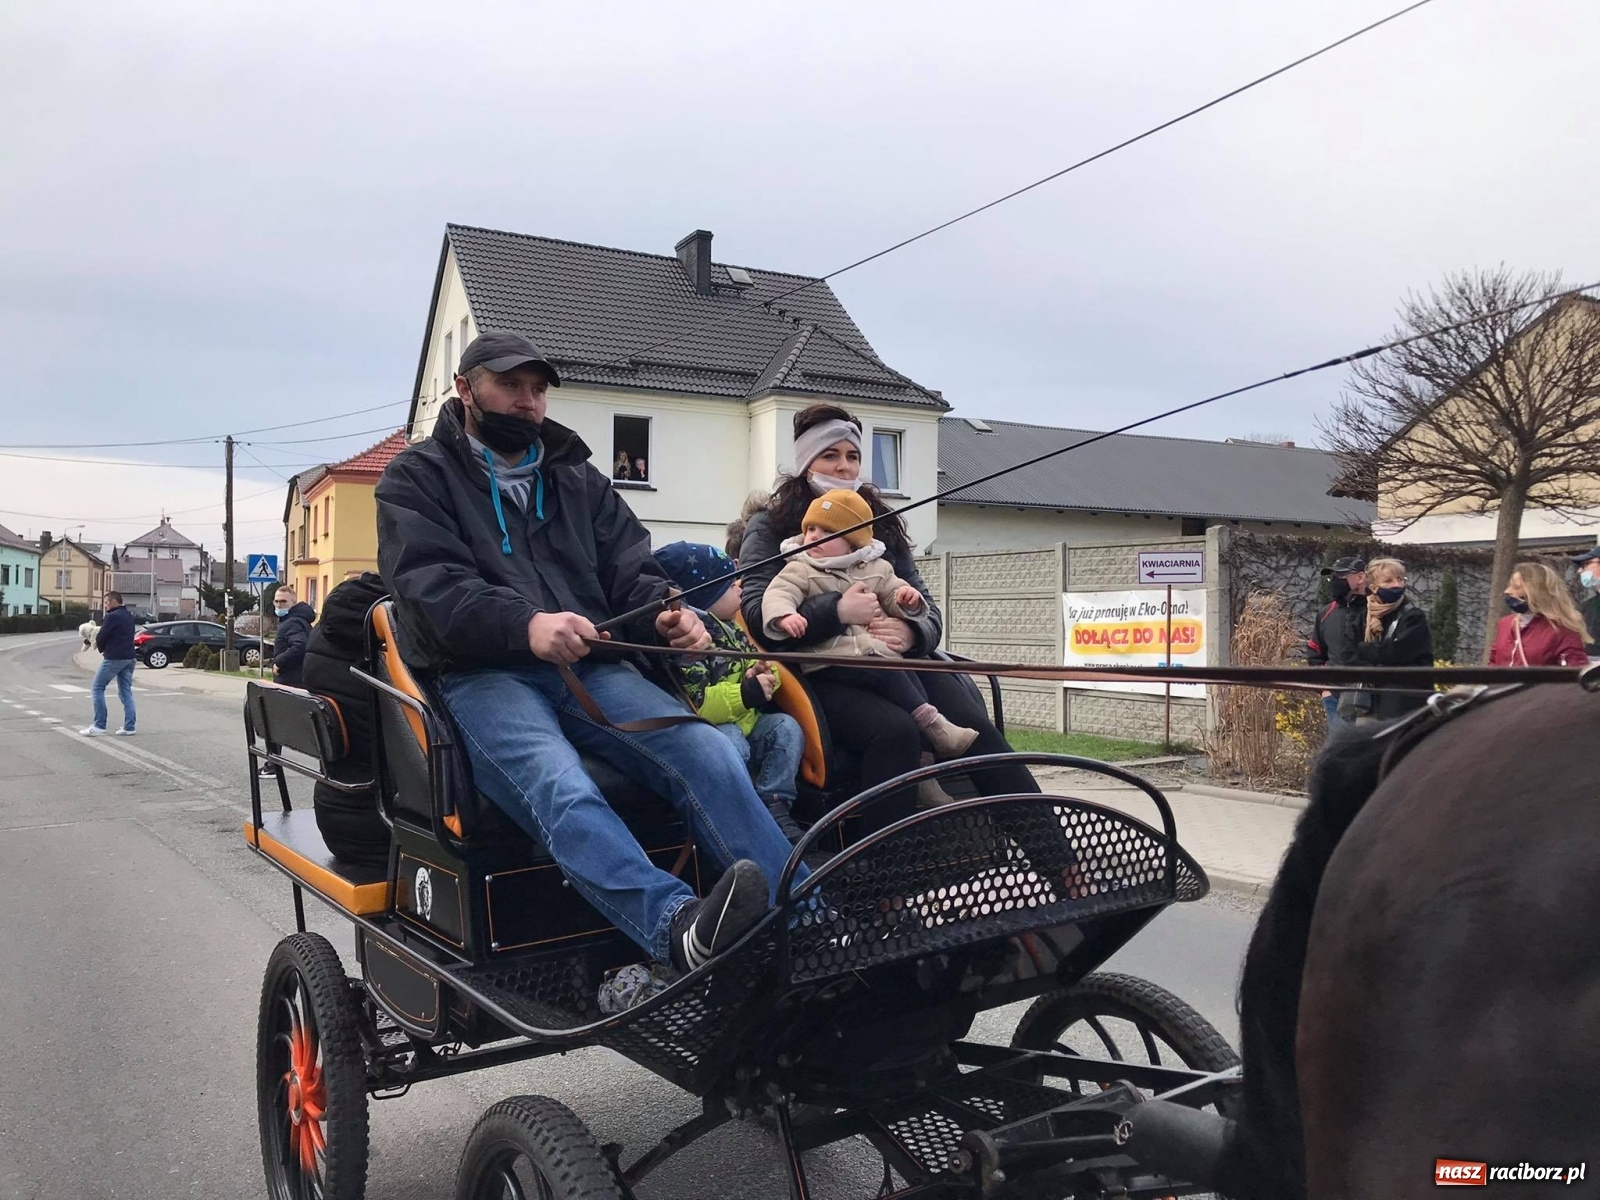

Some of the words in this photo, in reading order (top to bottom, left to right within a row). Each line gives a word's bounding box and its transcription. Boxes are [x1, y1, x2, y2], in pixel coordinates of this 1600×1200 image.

[1142, 559, 1200, 568] KWIACIARNIA
[1076, 606, 1095, 622] już
[1093, 603, 1128, 621] pracuję
[1129, 606, 1137, 616] w
[1074, 628, 1130, 649] DOŁĄCZ
[1132, 627, 1154, 644] DO
